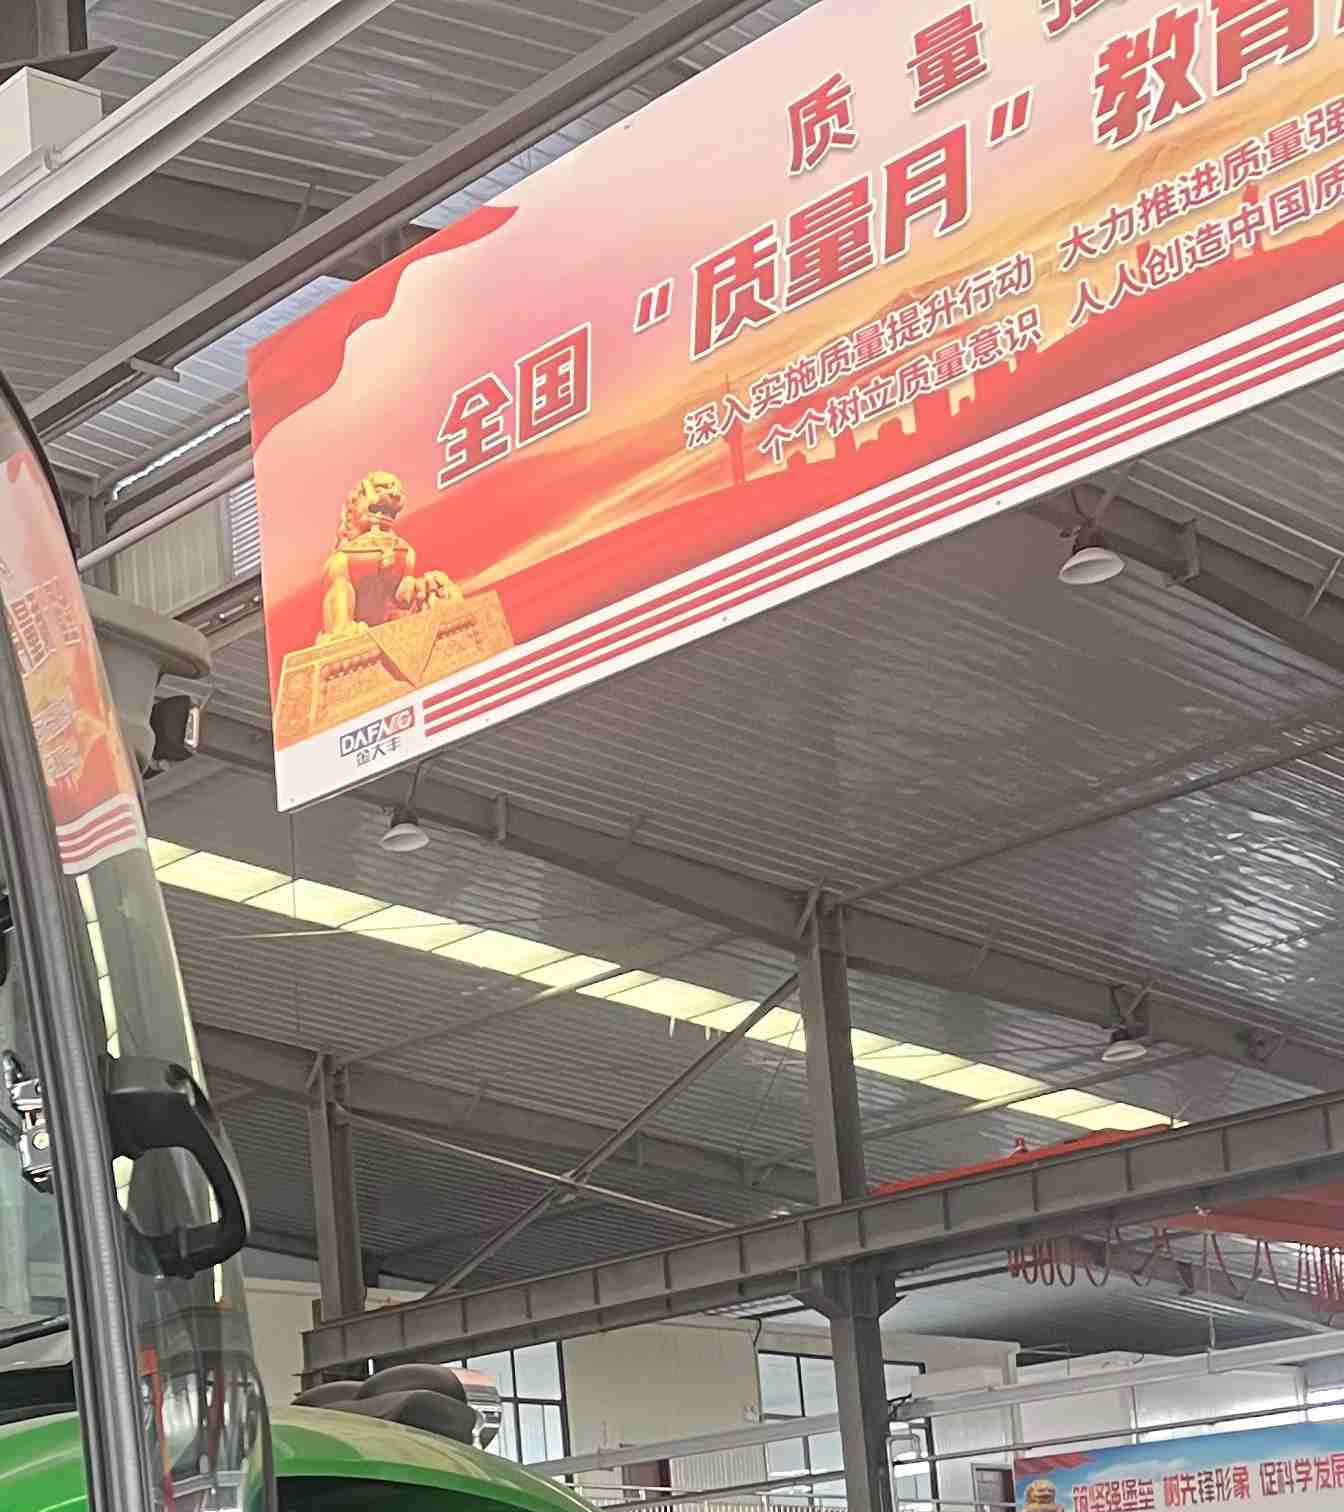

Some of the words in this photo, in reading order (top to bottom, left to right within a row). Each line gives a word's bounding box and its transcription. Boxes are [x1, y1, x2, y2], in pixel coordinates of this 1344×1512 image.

[684, 253, 1033, 449] 深入实施质量提升行动
[758, 306, 1043, 464] 个个树立质量意识
